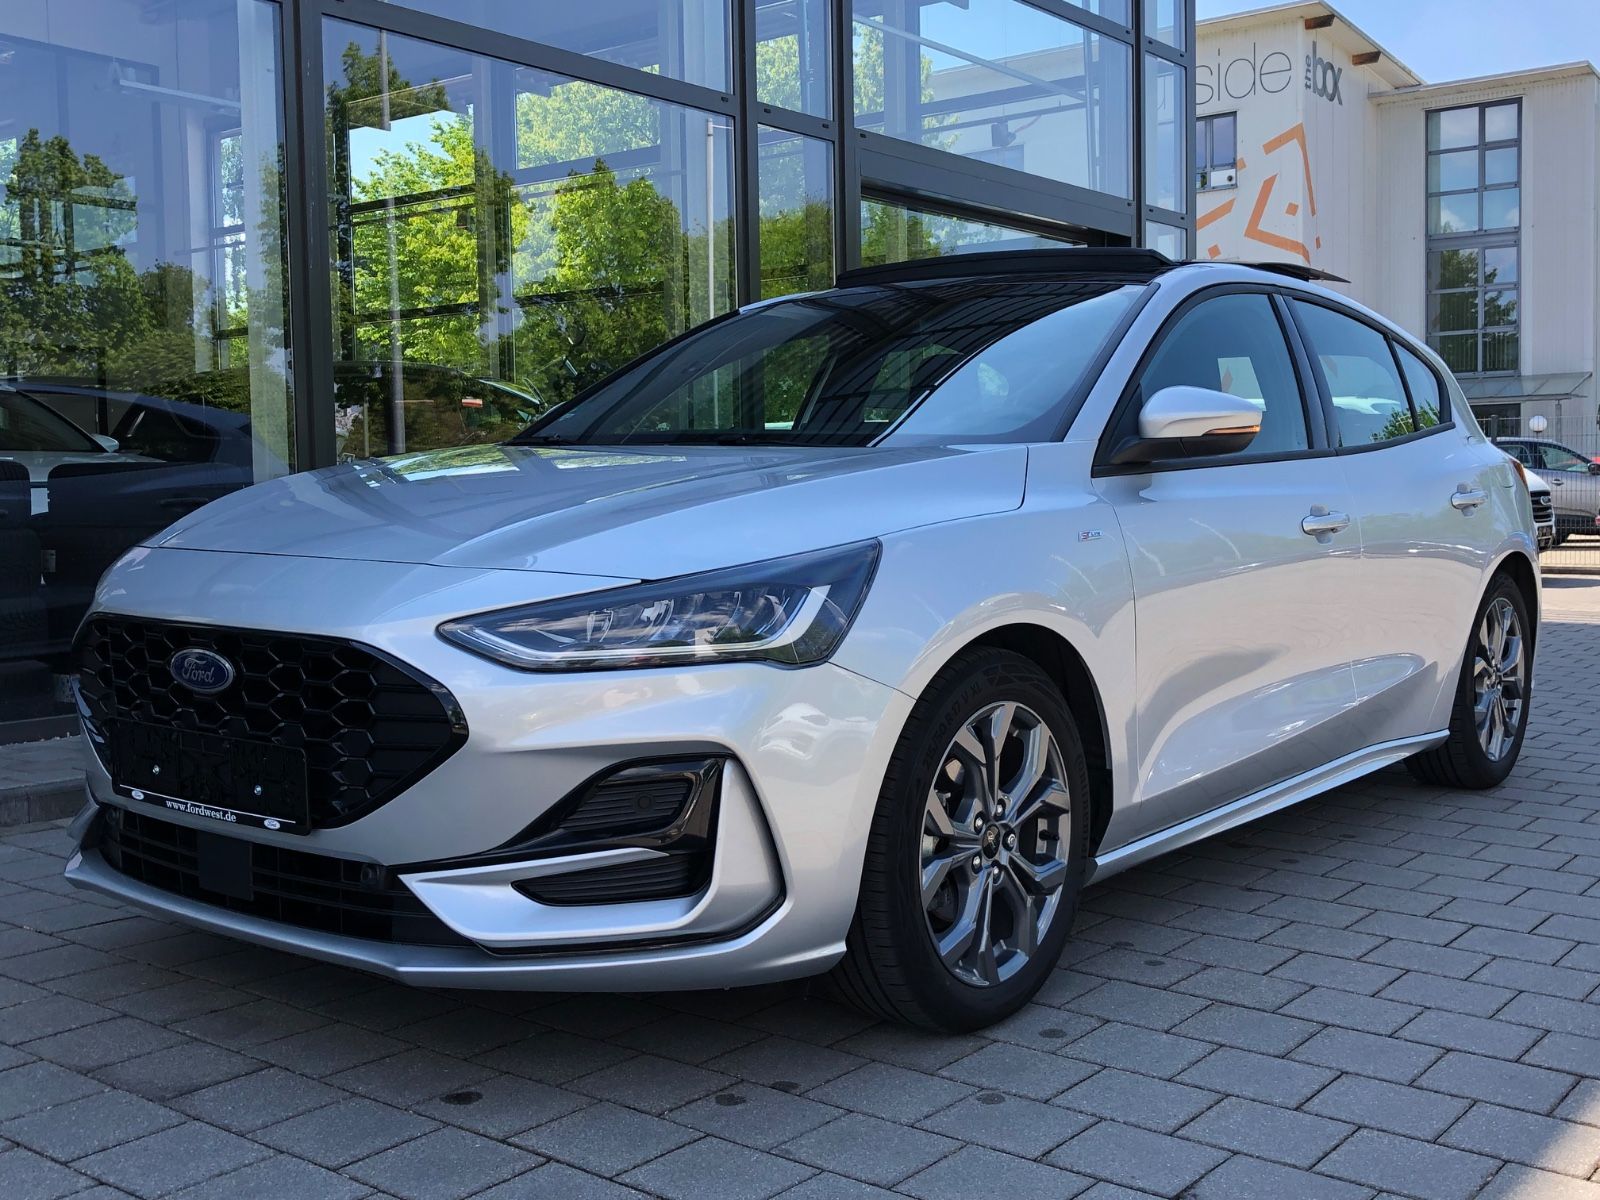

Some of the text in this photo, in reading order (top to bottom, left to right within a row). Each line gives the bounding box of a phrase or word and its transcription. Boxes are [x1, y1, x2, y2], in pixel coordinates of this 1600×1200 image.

[1196, 42, 1292, 106] side
[1304, 40, 1343, 106] the box
[182, 657, 215, 683] Ford
[165, 800, 237, 823] www.fordwest.de
